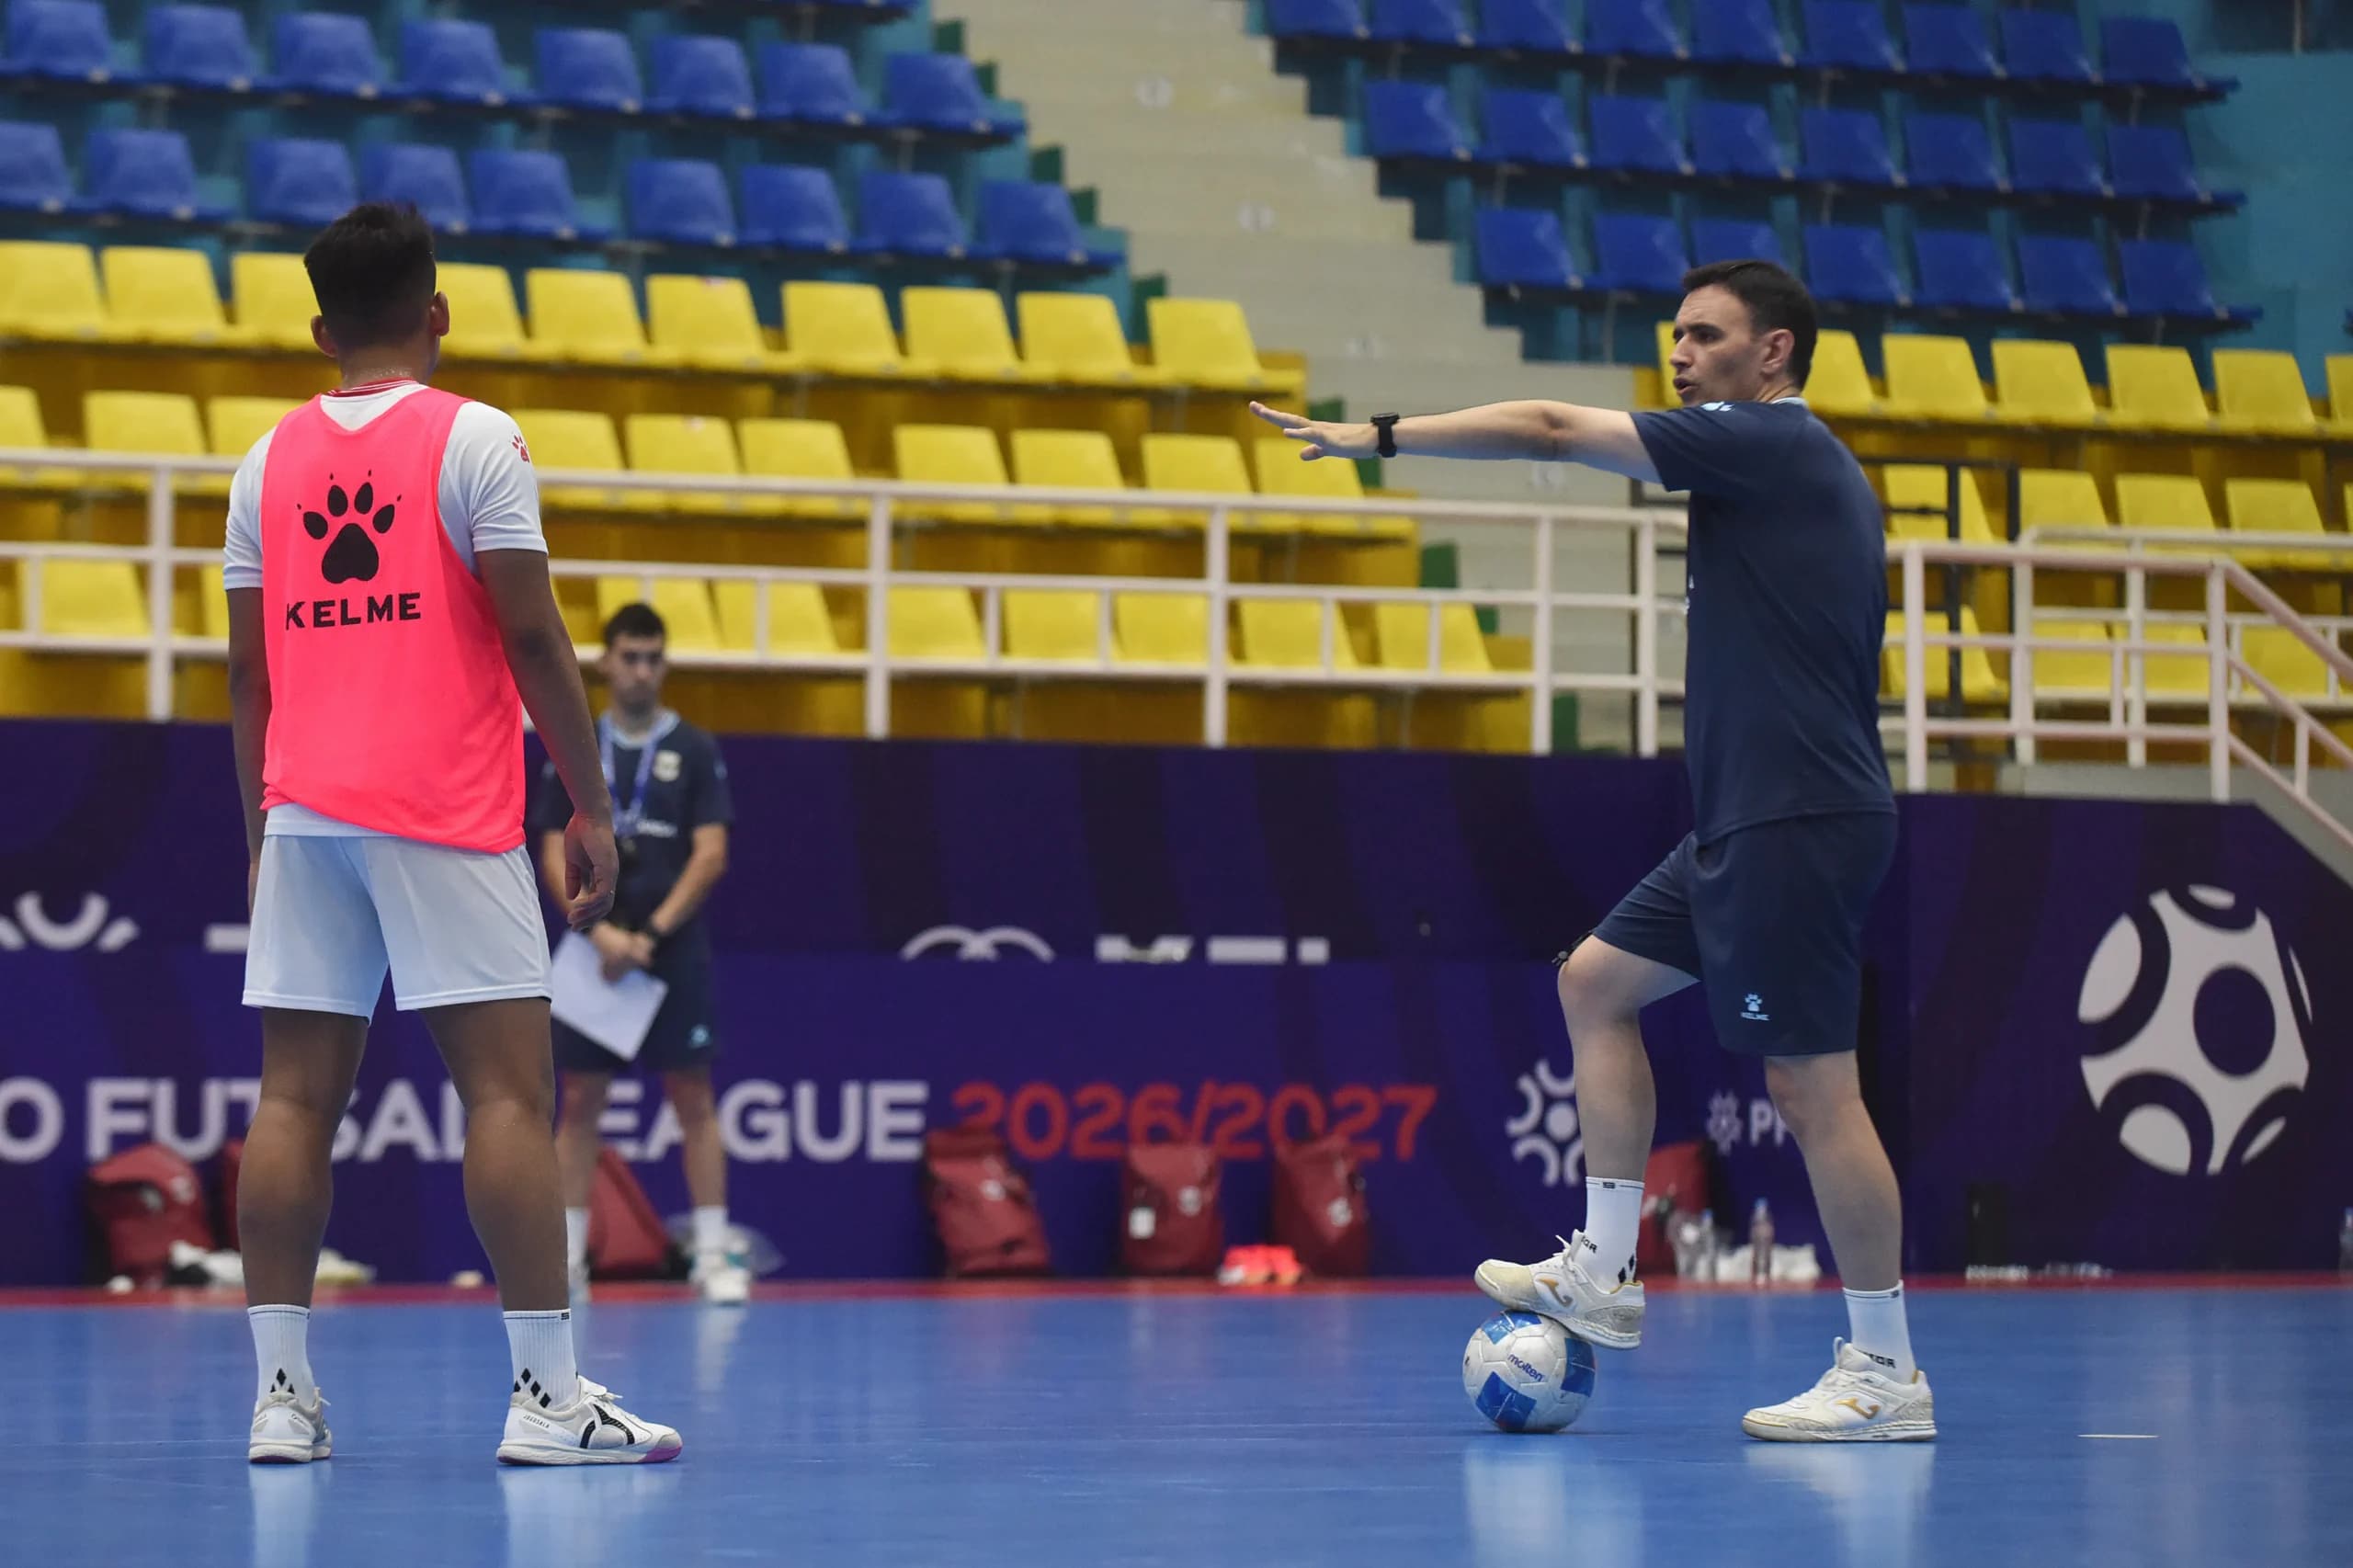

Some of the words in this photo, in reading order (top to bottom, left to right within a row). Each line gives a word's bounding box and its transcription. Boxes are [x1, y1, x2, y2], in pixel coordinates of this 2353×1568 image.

[286, 592, 421, 631] KELME
[952, 1081, 1436, 1161] 2026/2027
[1508, 1354, 1545, 1382] molten
